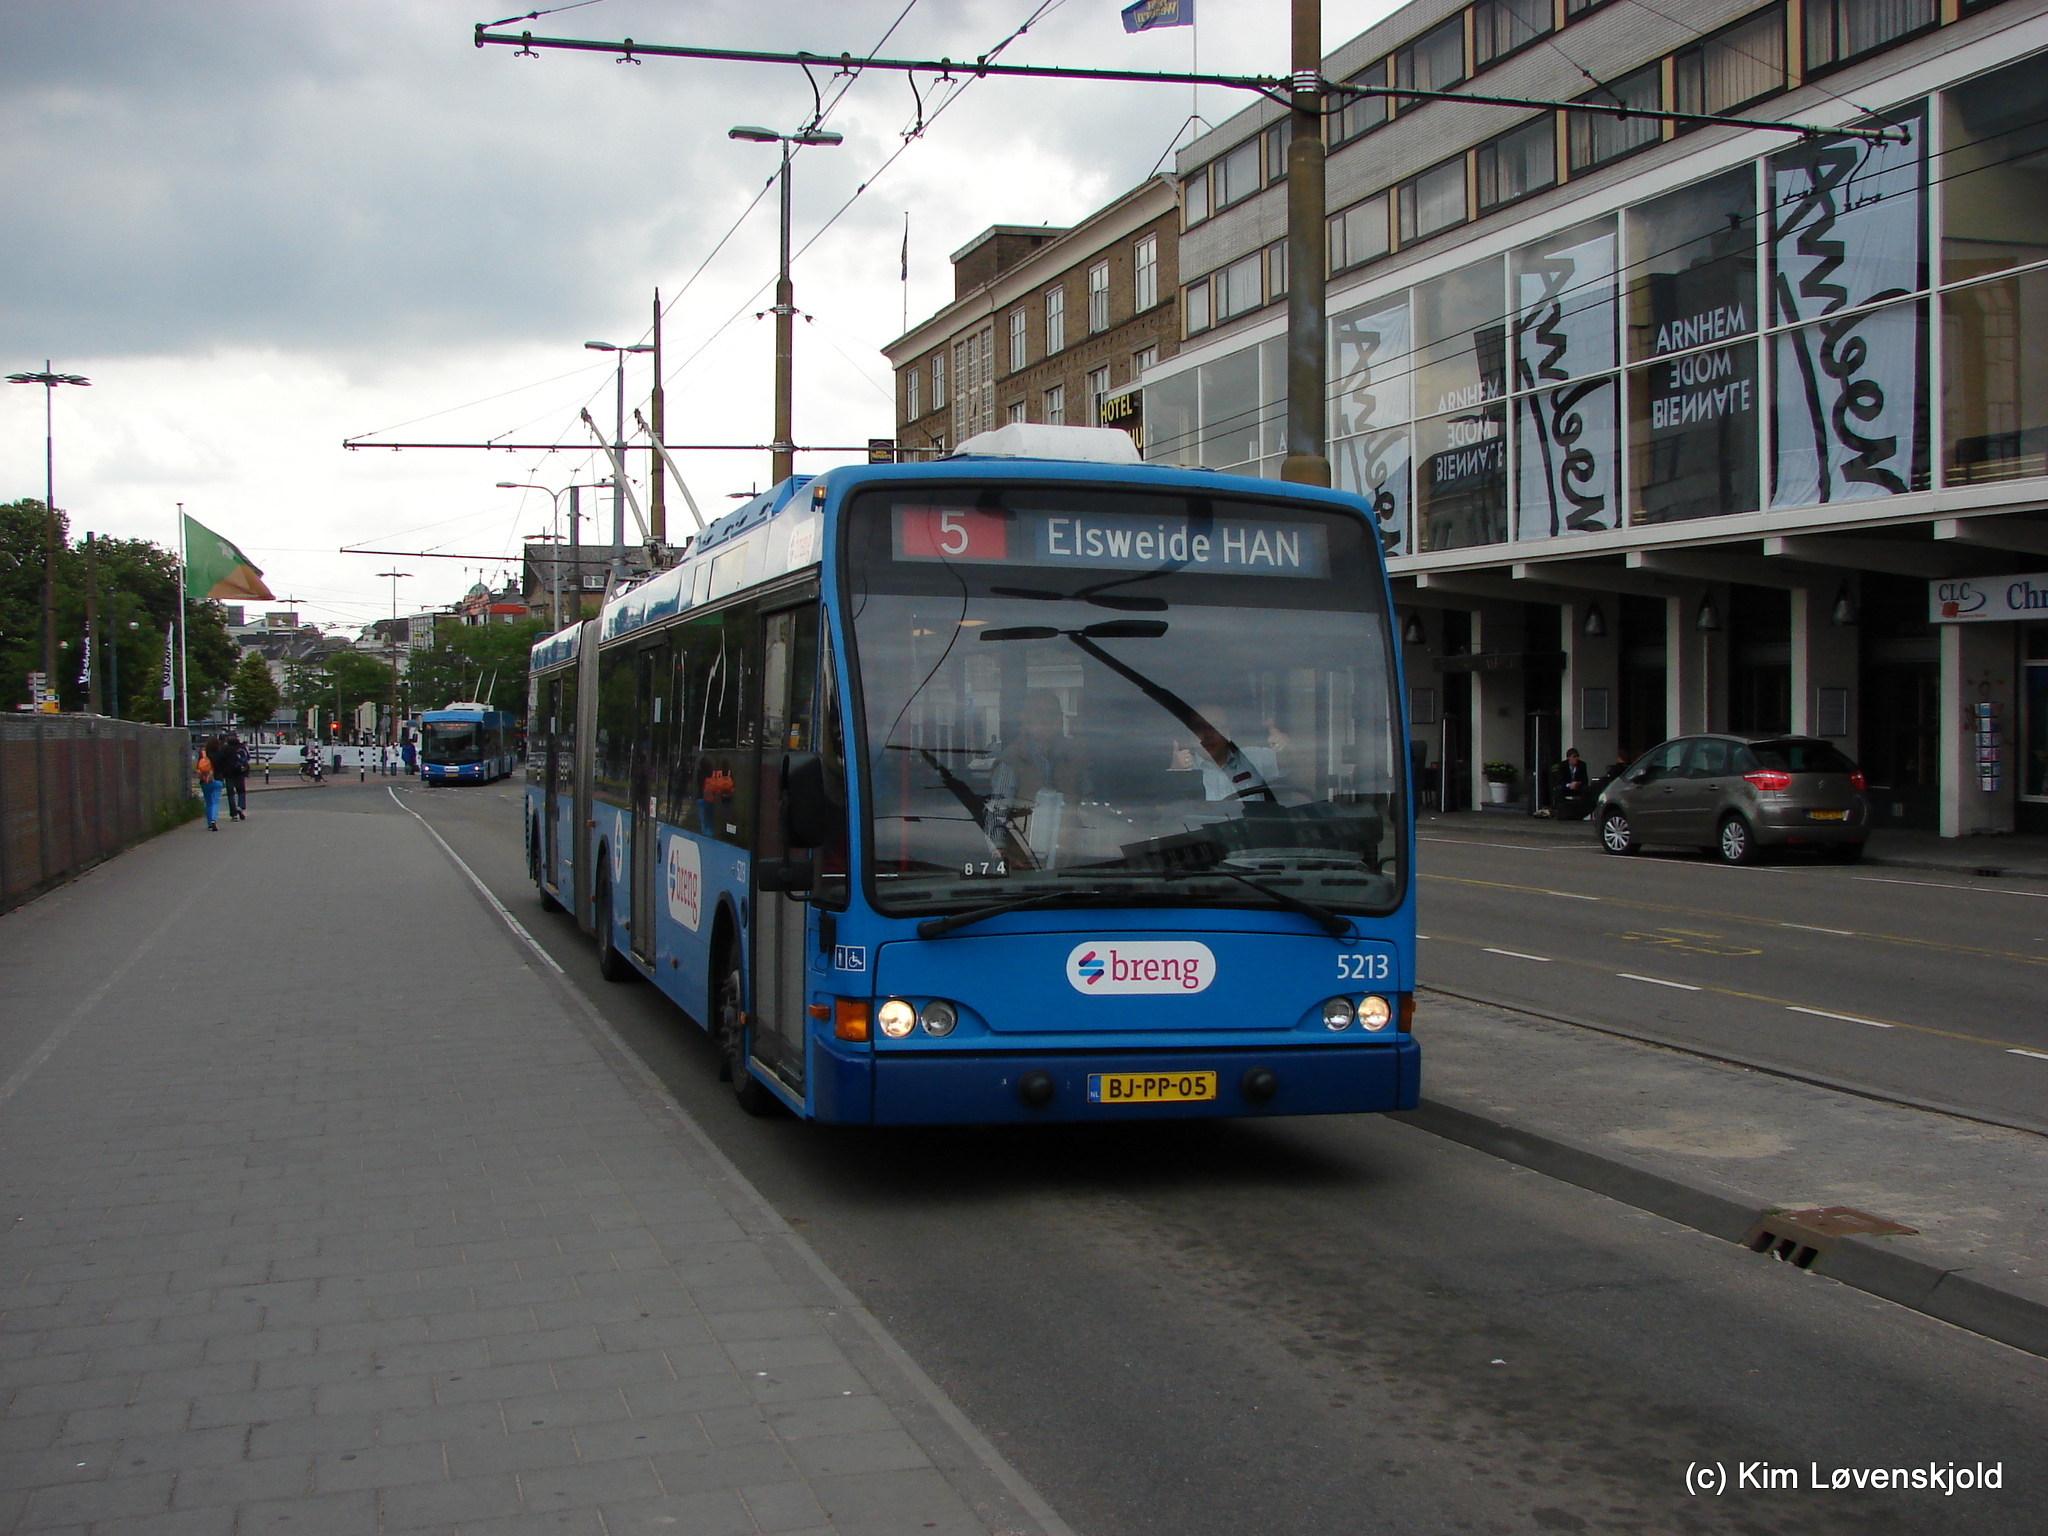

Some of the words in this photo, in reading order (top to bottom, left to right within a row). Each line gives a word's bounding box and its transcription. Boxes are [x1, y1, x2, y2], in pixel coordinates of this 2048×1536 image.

[1656, 301, 1746, 354] ARNHEM
[1100, 394, 1133, 424] HOTEL
[1438, 377, 1499, 413] ARNHEM
[940, 511, 969, 555] 5
[1048, 518, 1210, 563] Elsweide
[1223, 527, 1300, 567] HAN
[1938, 582, 1970, 602] CLC
[676, 849, 698, 925] breng
[1109, 950, 1200, 989] breng
[1337, 954, 1389, 979] 5213
[1109, 1076, 1207, 1099] BJ-PP-05
